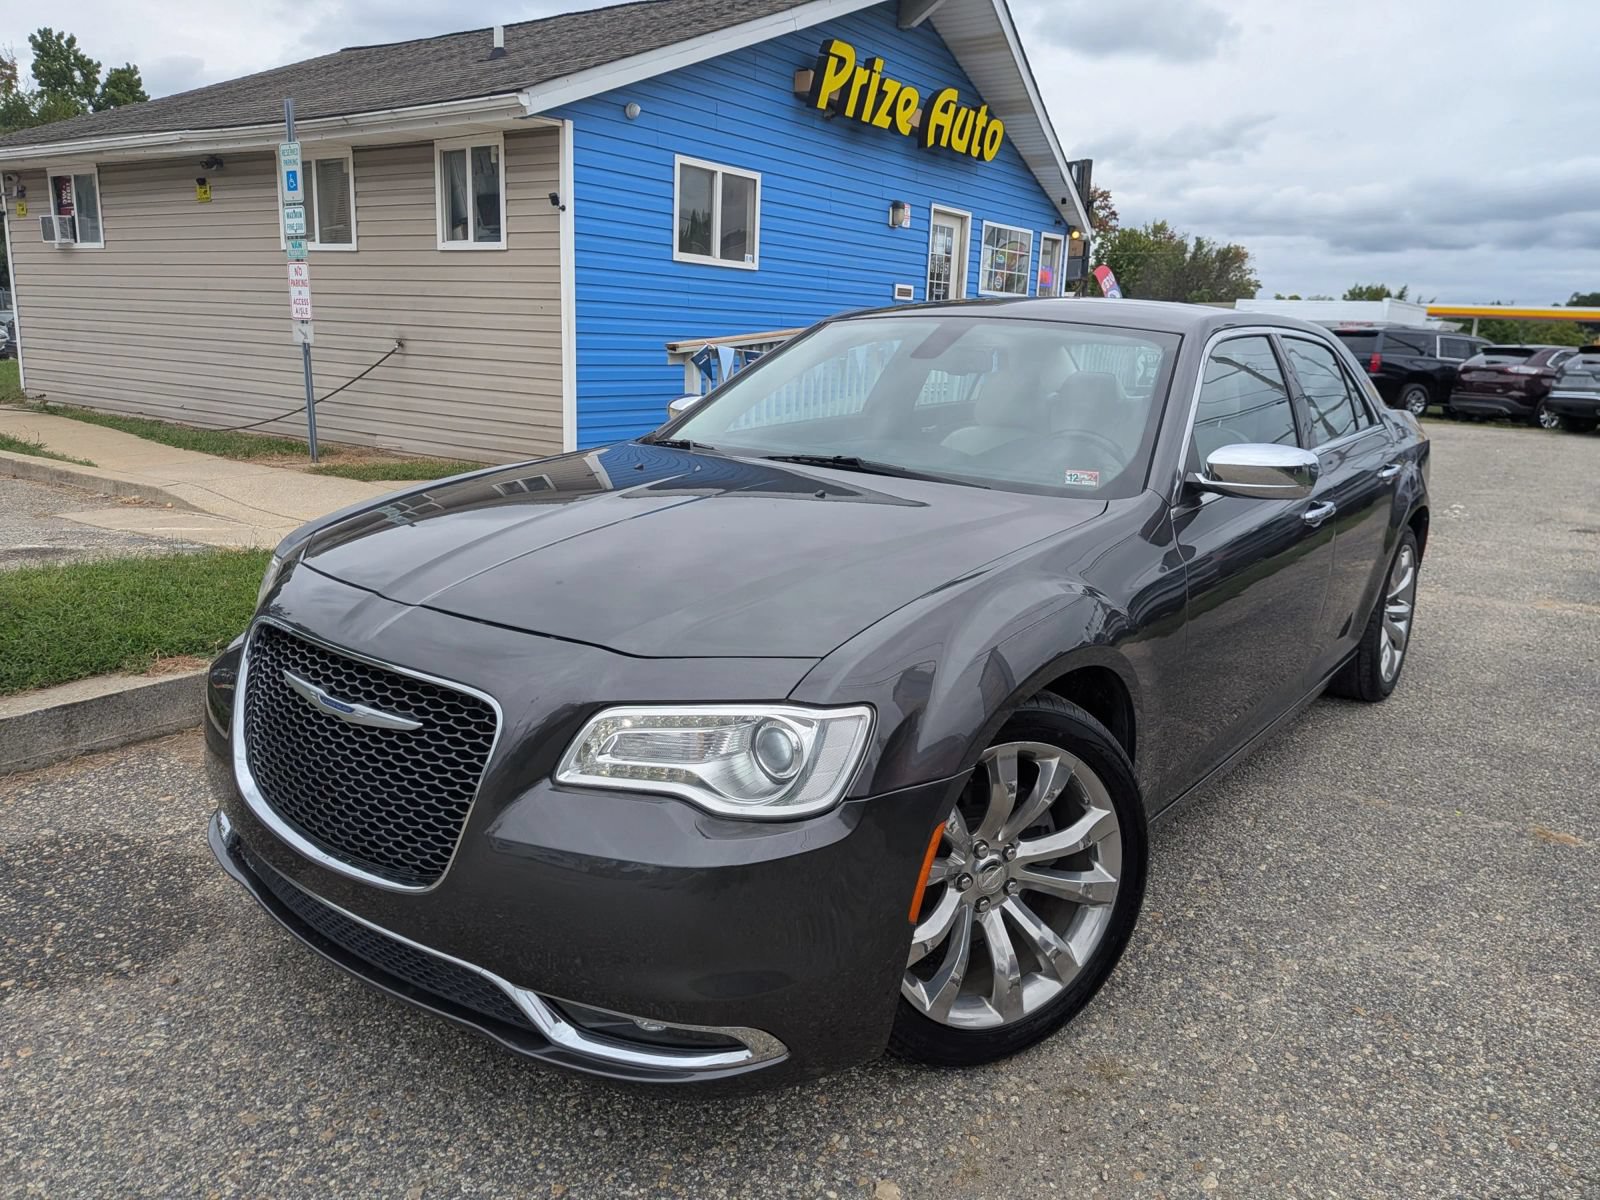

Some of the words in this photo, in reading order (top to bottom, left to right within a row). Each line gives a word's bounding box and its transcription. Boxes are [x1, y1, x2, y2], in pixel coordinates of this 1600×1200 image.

[816, 39, 921, 137] Prize
[926, 87, 1005, 162] Auto
[283, 158, 299, 166] PARKING
[294, 267, 303, 277] NO
[289, 279, 309, 288] PARKING
[293, 298, 309, 306] ACCESS
[295, 307, 309, 317] AISLE
[1068, 473, 1079, 482] 12
